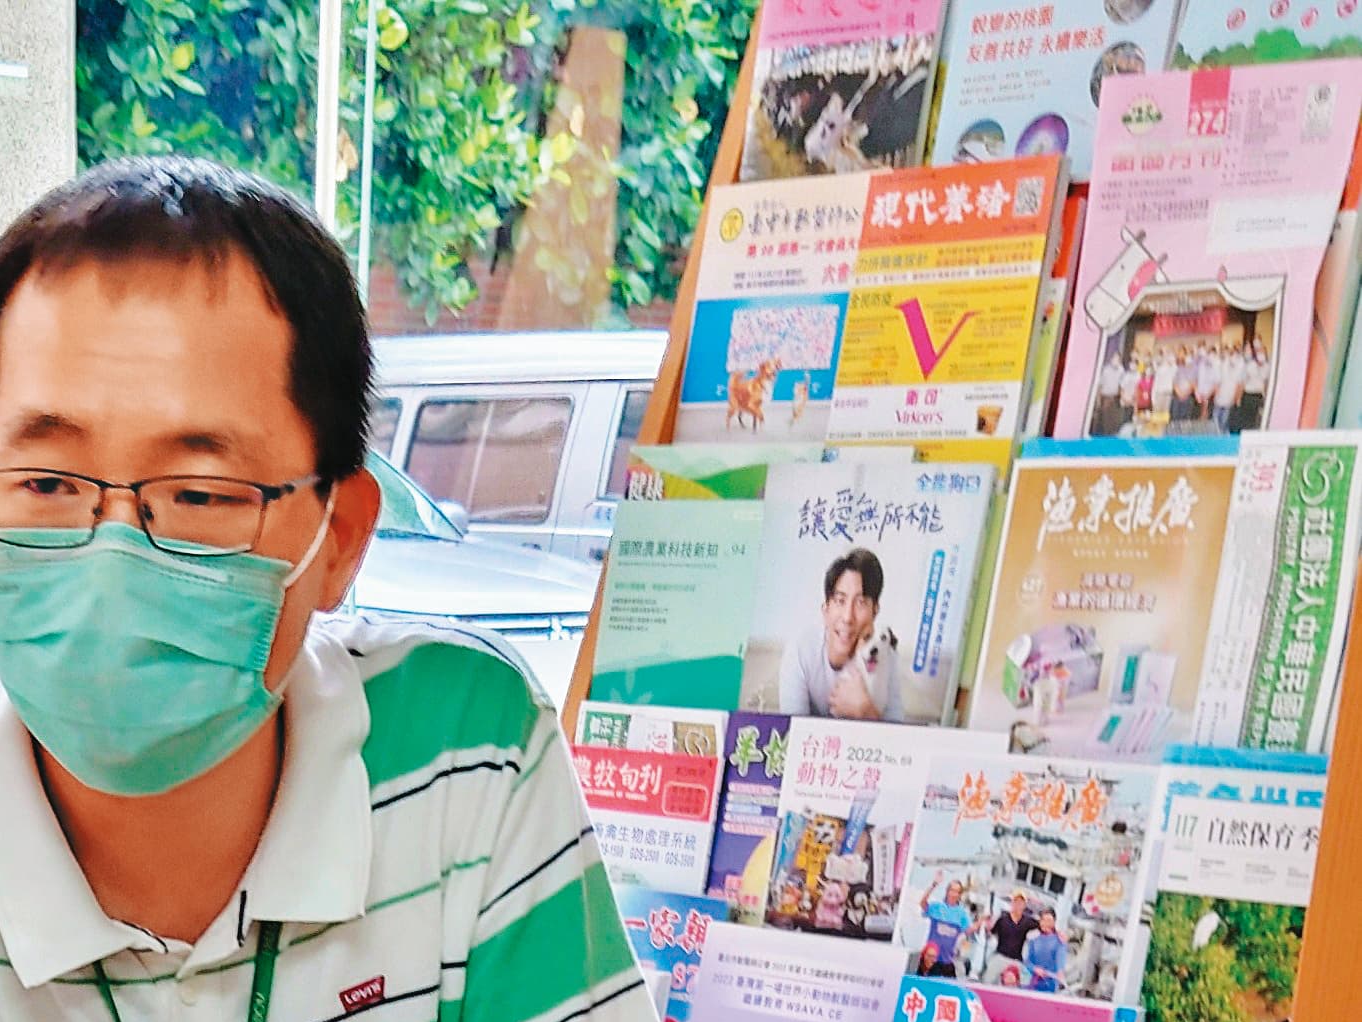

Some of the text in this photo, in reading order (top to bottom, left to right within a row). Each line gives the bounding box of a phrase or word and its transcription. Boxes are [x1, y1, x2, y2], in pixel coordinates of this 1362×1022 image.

[968, 25, 1106, 64] 友善共好 永續樂活
[798, 488, 944, 542] 讓愛無所不能
[1036, 473, 1198, 552] 漁業推廣
[618, 540, 719, 559] 國際農業科技新知
[802, 735, 842, 760] 台灣
[846, 746, 883, 763] 2022
[796, 761, 881, 790] 動物之聲
[953, 769, 1109, 836] 漁業推廣
[1175, 813, 1199, 838] 117
[786, 1001, 824, 1018] WSAVA
[828, 1007, 844, 1021] CE
